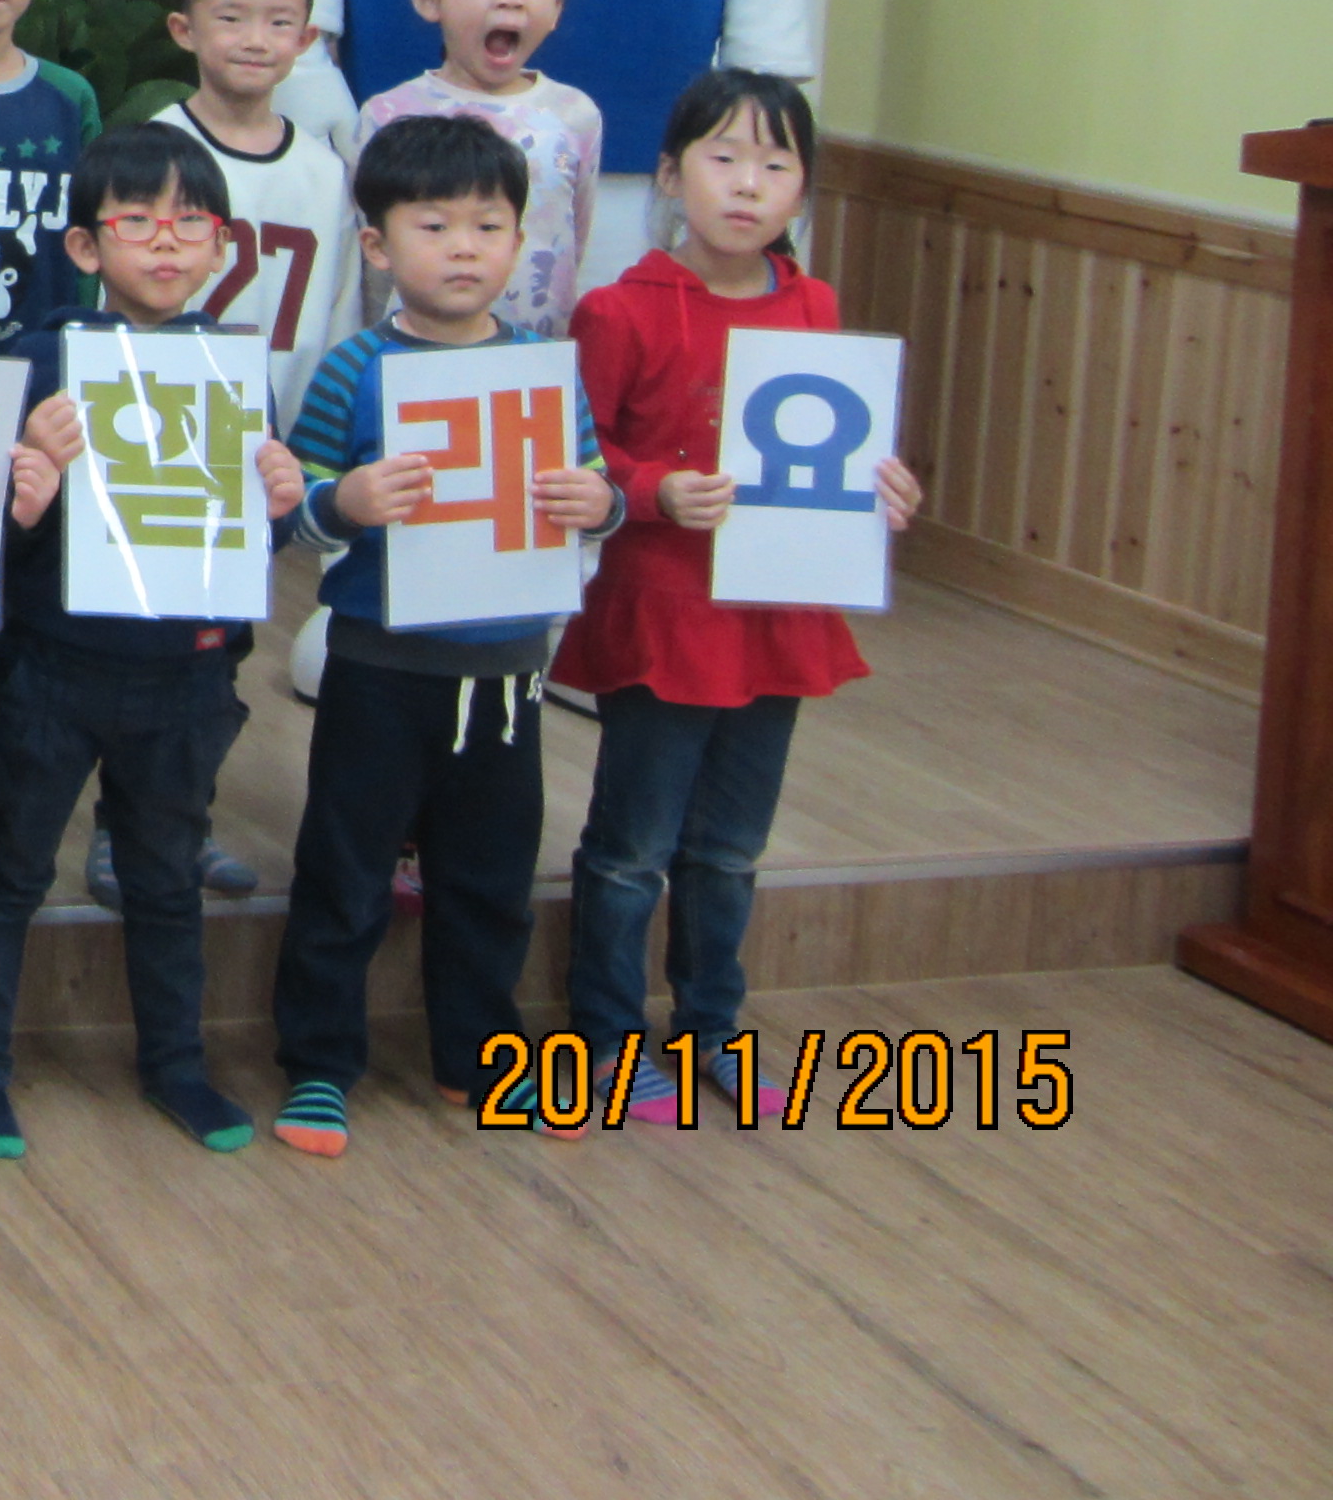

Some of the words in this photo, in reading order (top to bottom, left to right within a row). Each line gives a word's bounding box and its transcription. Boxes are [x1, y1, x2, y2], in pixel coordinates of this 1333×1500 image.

[200, 218, 318, 352] 27
[80, 370, 263, 549] 할
[398, 385, 567, 553] 래
[734, 373, 876, 512] 요
